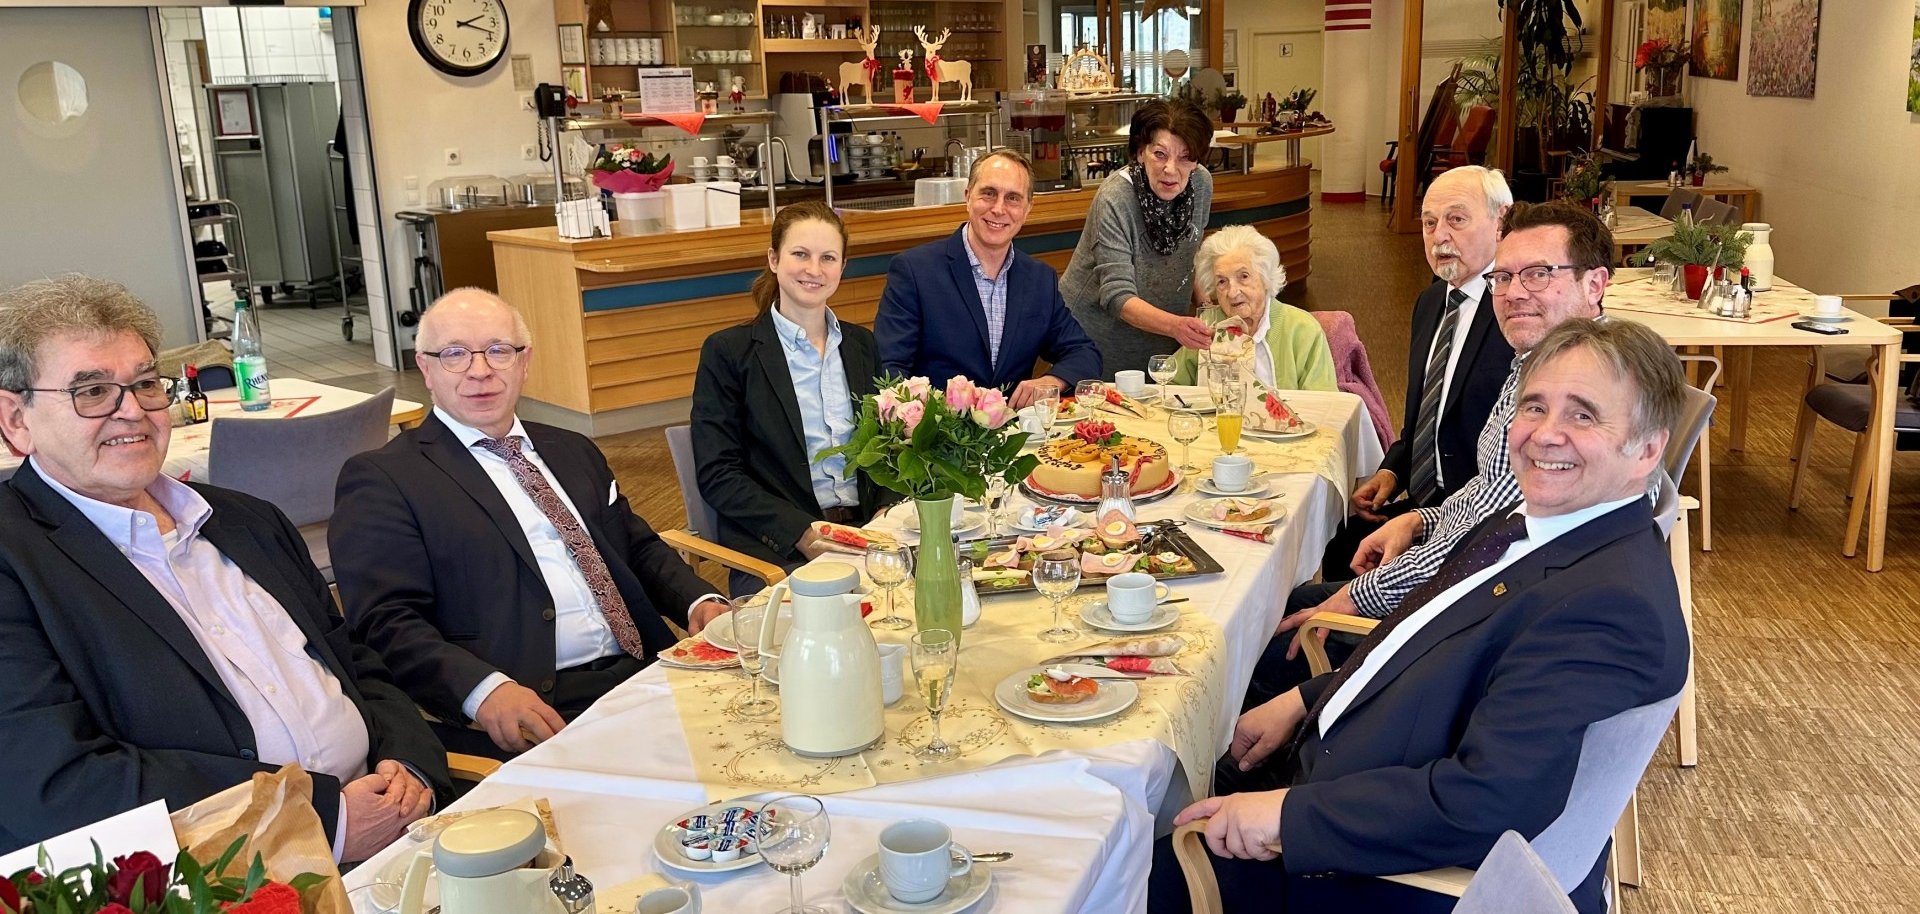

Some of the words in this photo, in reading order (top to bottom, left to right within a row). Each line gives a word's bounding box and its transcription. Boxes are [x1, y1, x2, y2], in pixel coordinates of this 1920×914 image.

[433, 5, 445, 16] 10
[481, 1, 489, 12] 2
[429, 18, 438, 29] 9
[489, 17, 496, 28] 3
[436, 33, 444, 44] 8
[449, 44, 457, 55] 7
[463, 48, 471, 58] 6
[478, 43, 486, 54] 5
